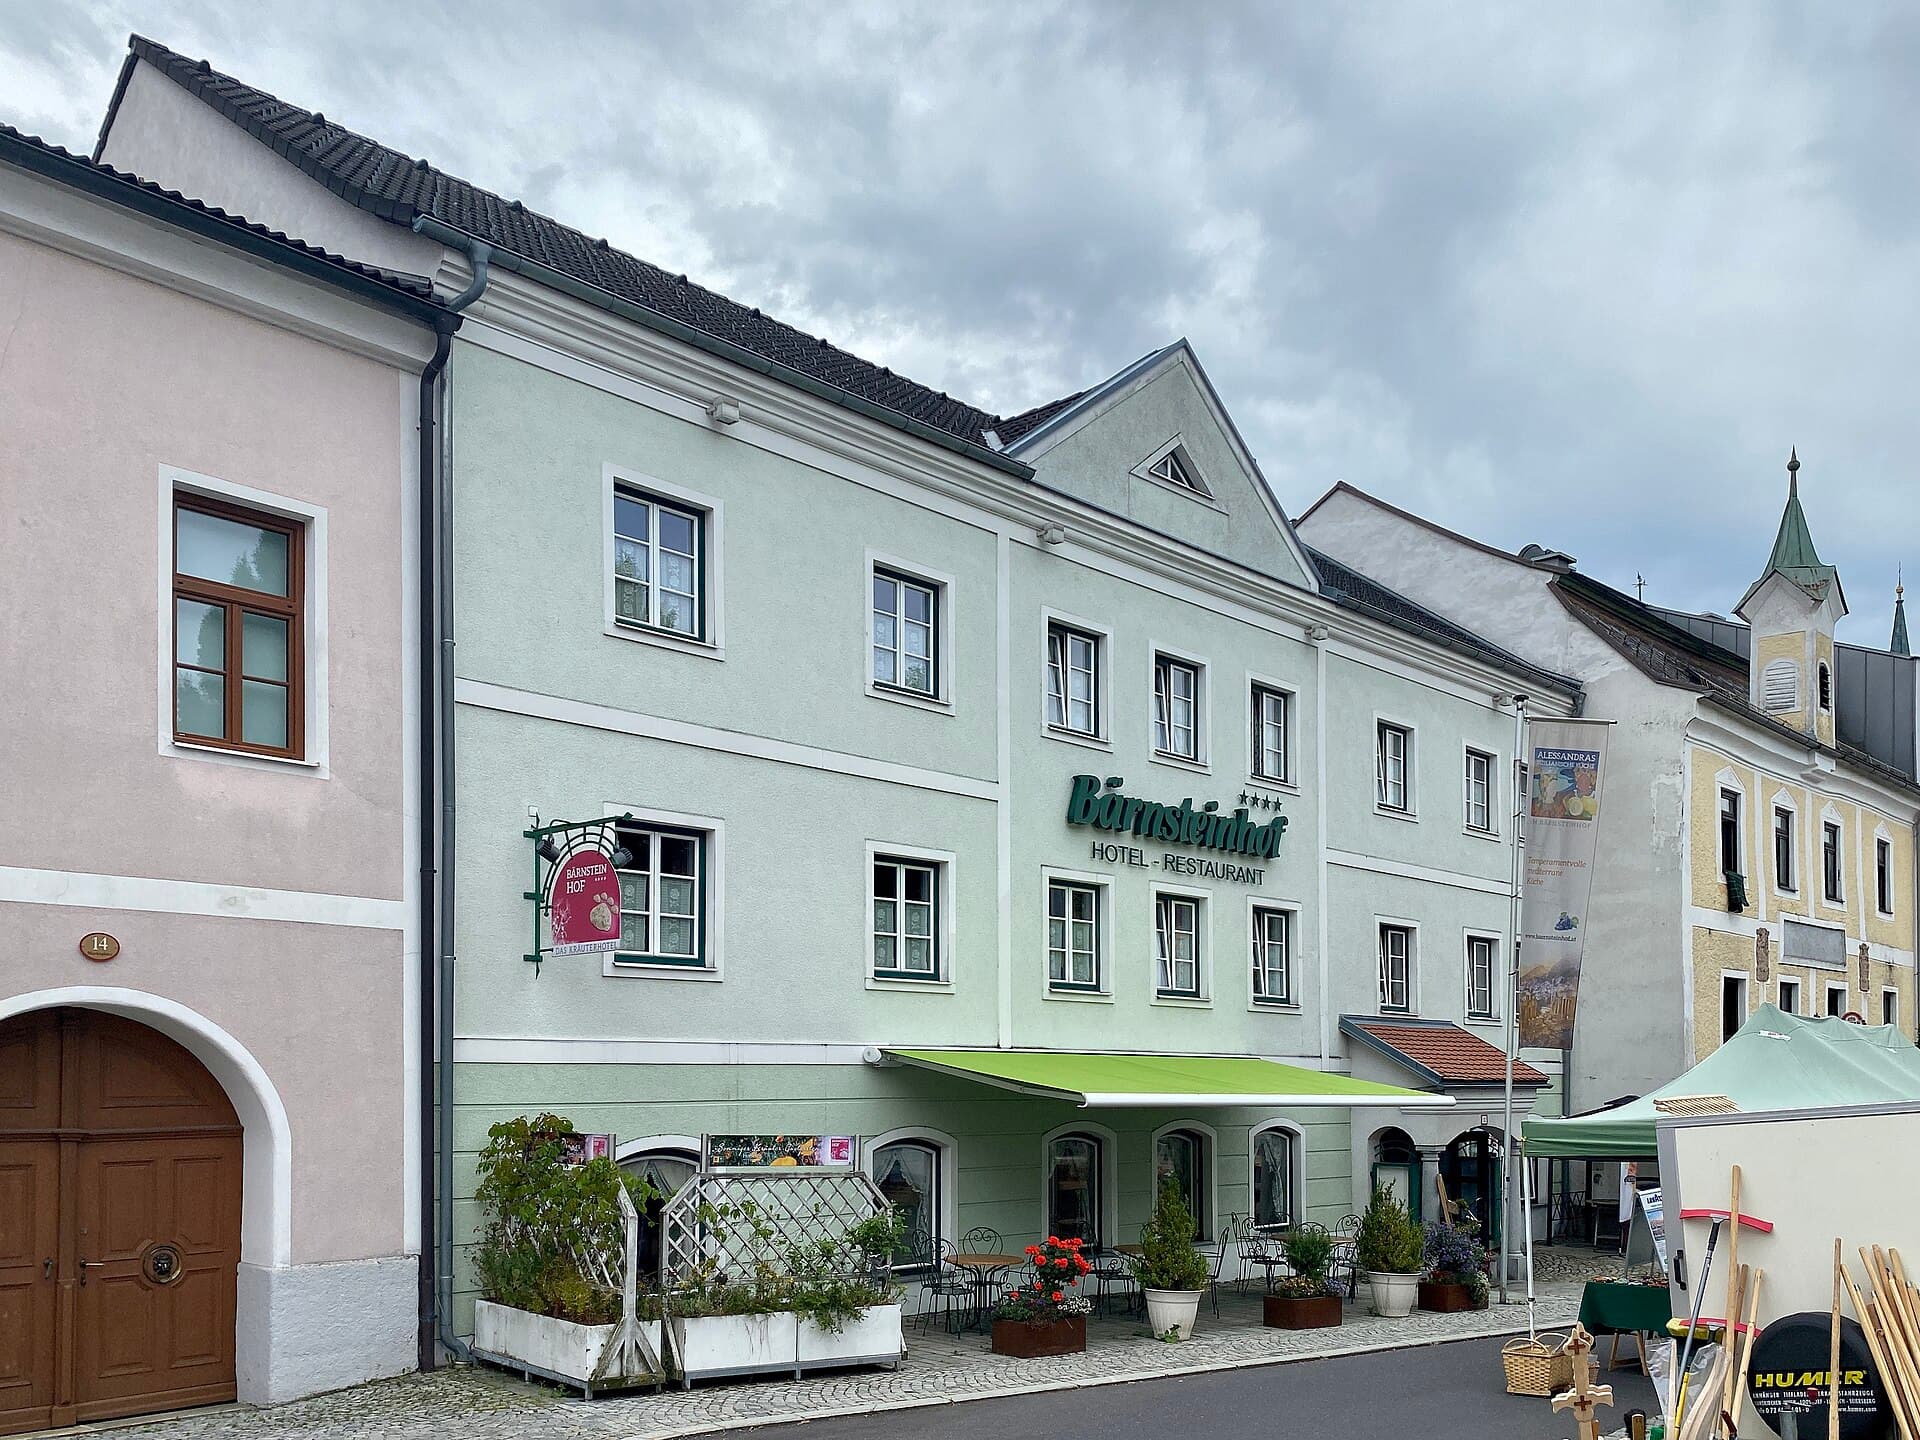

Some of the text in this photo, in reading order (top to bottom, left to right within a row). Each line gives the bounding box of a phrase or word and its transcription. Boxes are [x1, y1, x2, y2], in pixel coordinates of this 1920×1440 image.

[1537, 751, 1596, 762] ALESSANDRAS
[1066, 774, 1288, 859] Bärnsteinhof
[1091, 841, 1149, 868] HOTEL
[1163, 853, 1266, 886] RESTAURANT
[566, 864, 607, 879] BÄRNSTEIN
[566, 880, 586, 894] HOF
[92, 936, 108, 951] 14
[555, 941, 617, 955] DAS KRÄUTERHOTEL
[1838, 1405, 1877, 1413] ww.humer.com
